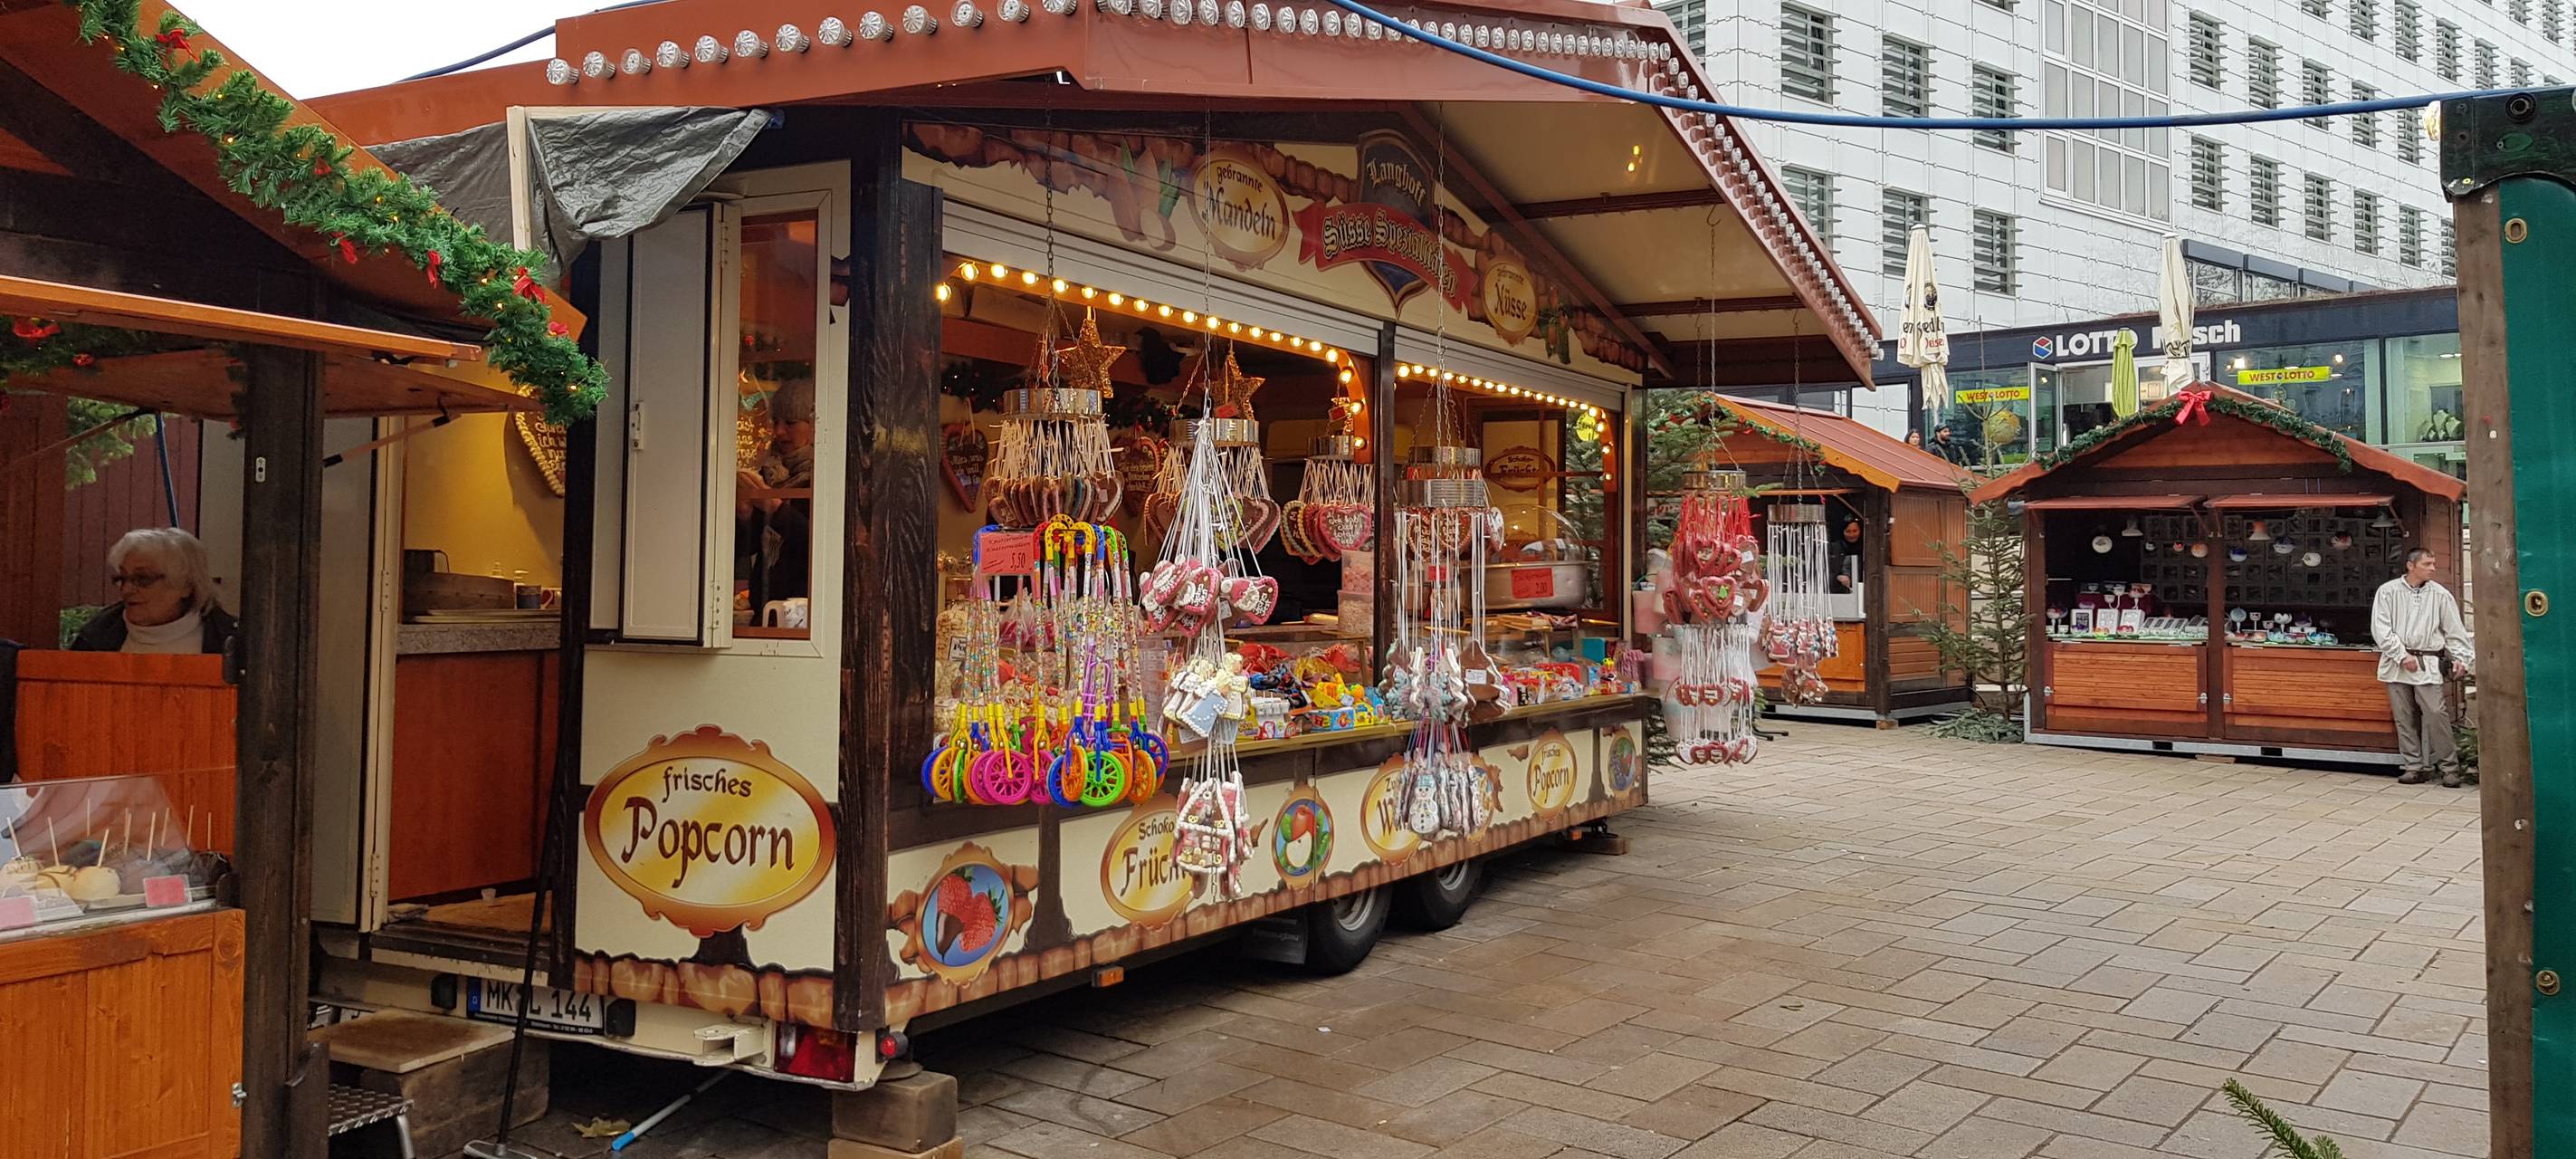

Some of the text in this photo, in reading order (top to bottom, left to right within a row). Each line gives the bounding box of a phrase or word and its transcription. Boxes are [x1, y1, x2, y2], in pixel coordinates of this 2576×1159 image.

[1216, 165, 1263, 193] gebrannte
[1366, 158, 1426, 207] Langhoff
[1202, 180, 1275, 241] Mandeln
[1322, 207, 1458, 298] Süsse Spezialitäten
[1494, 282, 1527, 321] Nüsse
[1966, 389, 2020, 400] WEST LOTTO
[2249, 370, 2315, 382] WEST LOTTO
[662, 765, 752, 803] frisches
[1533, 763, 1569, 805] Popcorn
[621, 796, 795, 888] Popcorn
[487, 980, 513, 1011] MK
[550, 990, 592, 1022] 144
